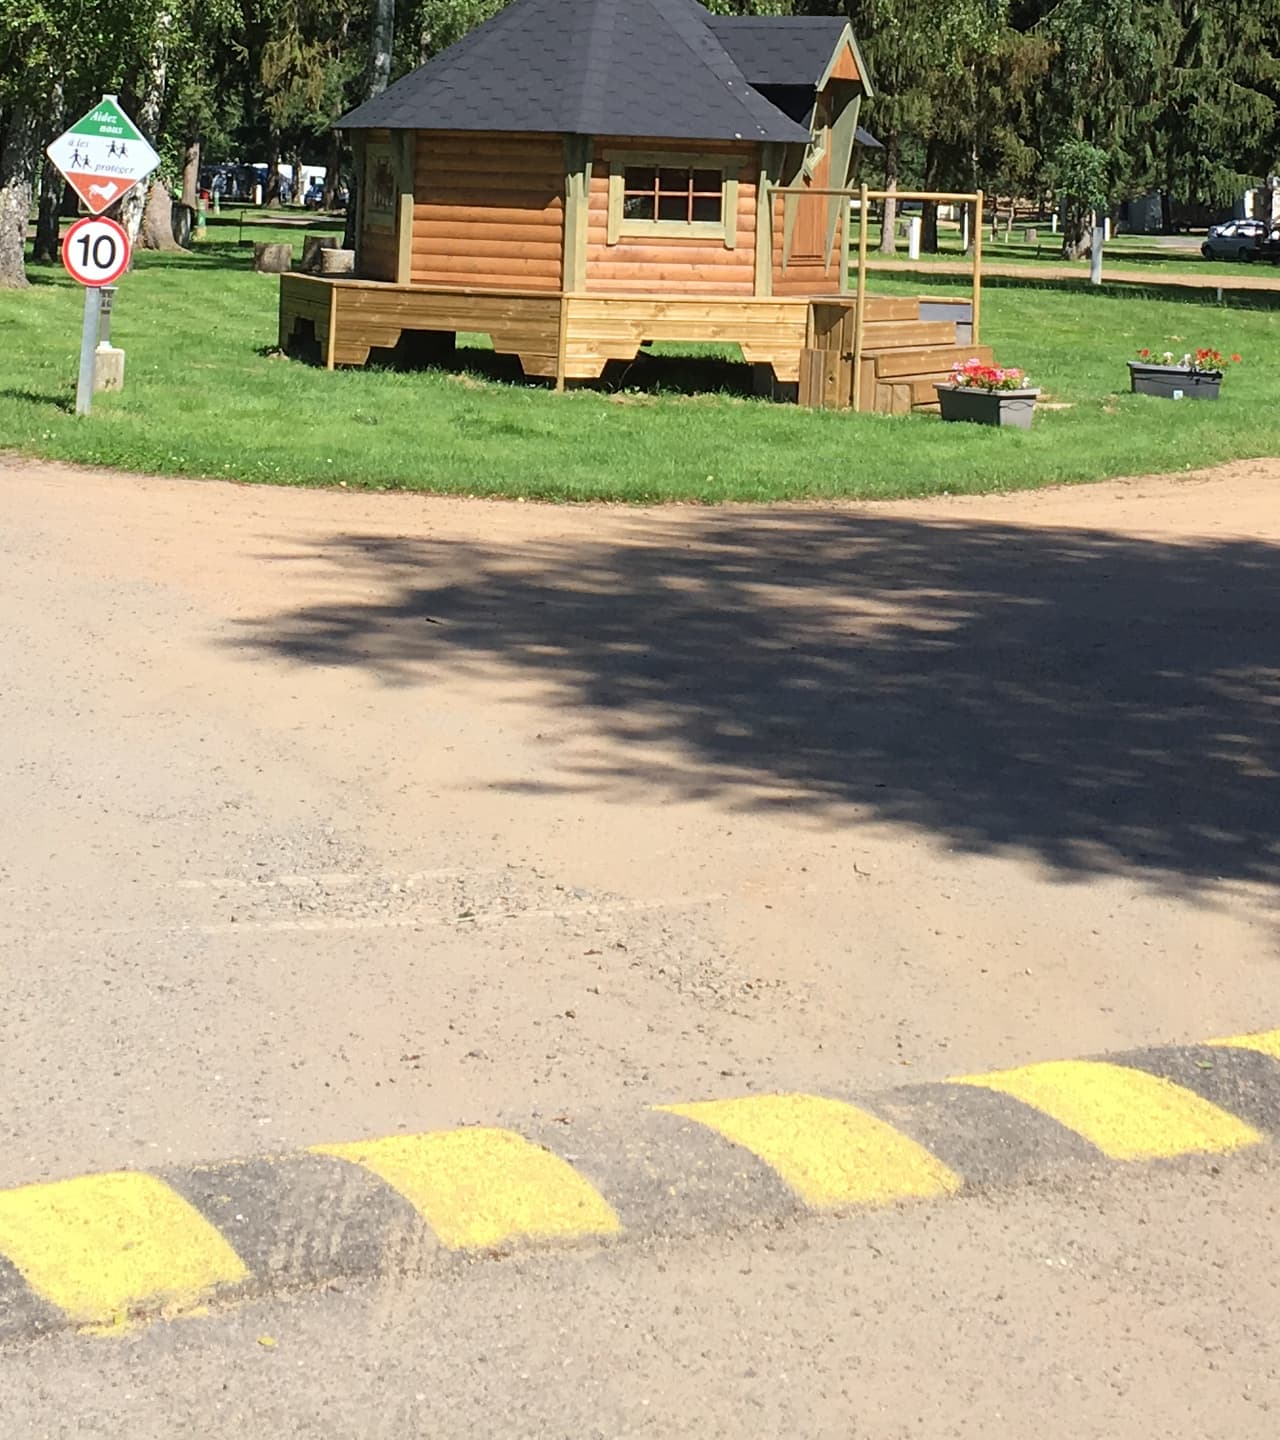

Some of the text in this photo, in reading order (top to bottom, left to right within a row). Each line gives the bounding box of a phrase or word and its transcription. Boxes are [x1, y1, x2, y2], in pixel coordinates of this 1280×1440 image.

[89, 111, 118, 124] Aidez
[99, 125, 124, 134] nous
[76, 139, 89, 148] les
[76, 234, 116, 269] 10
